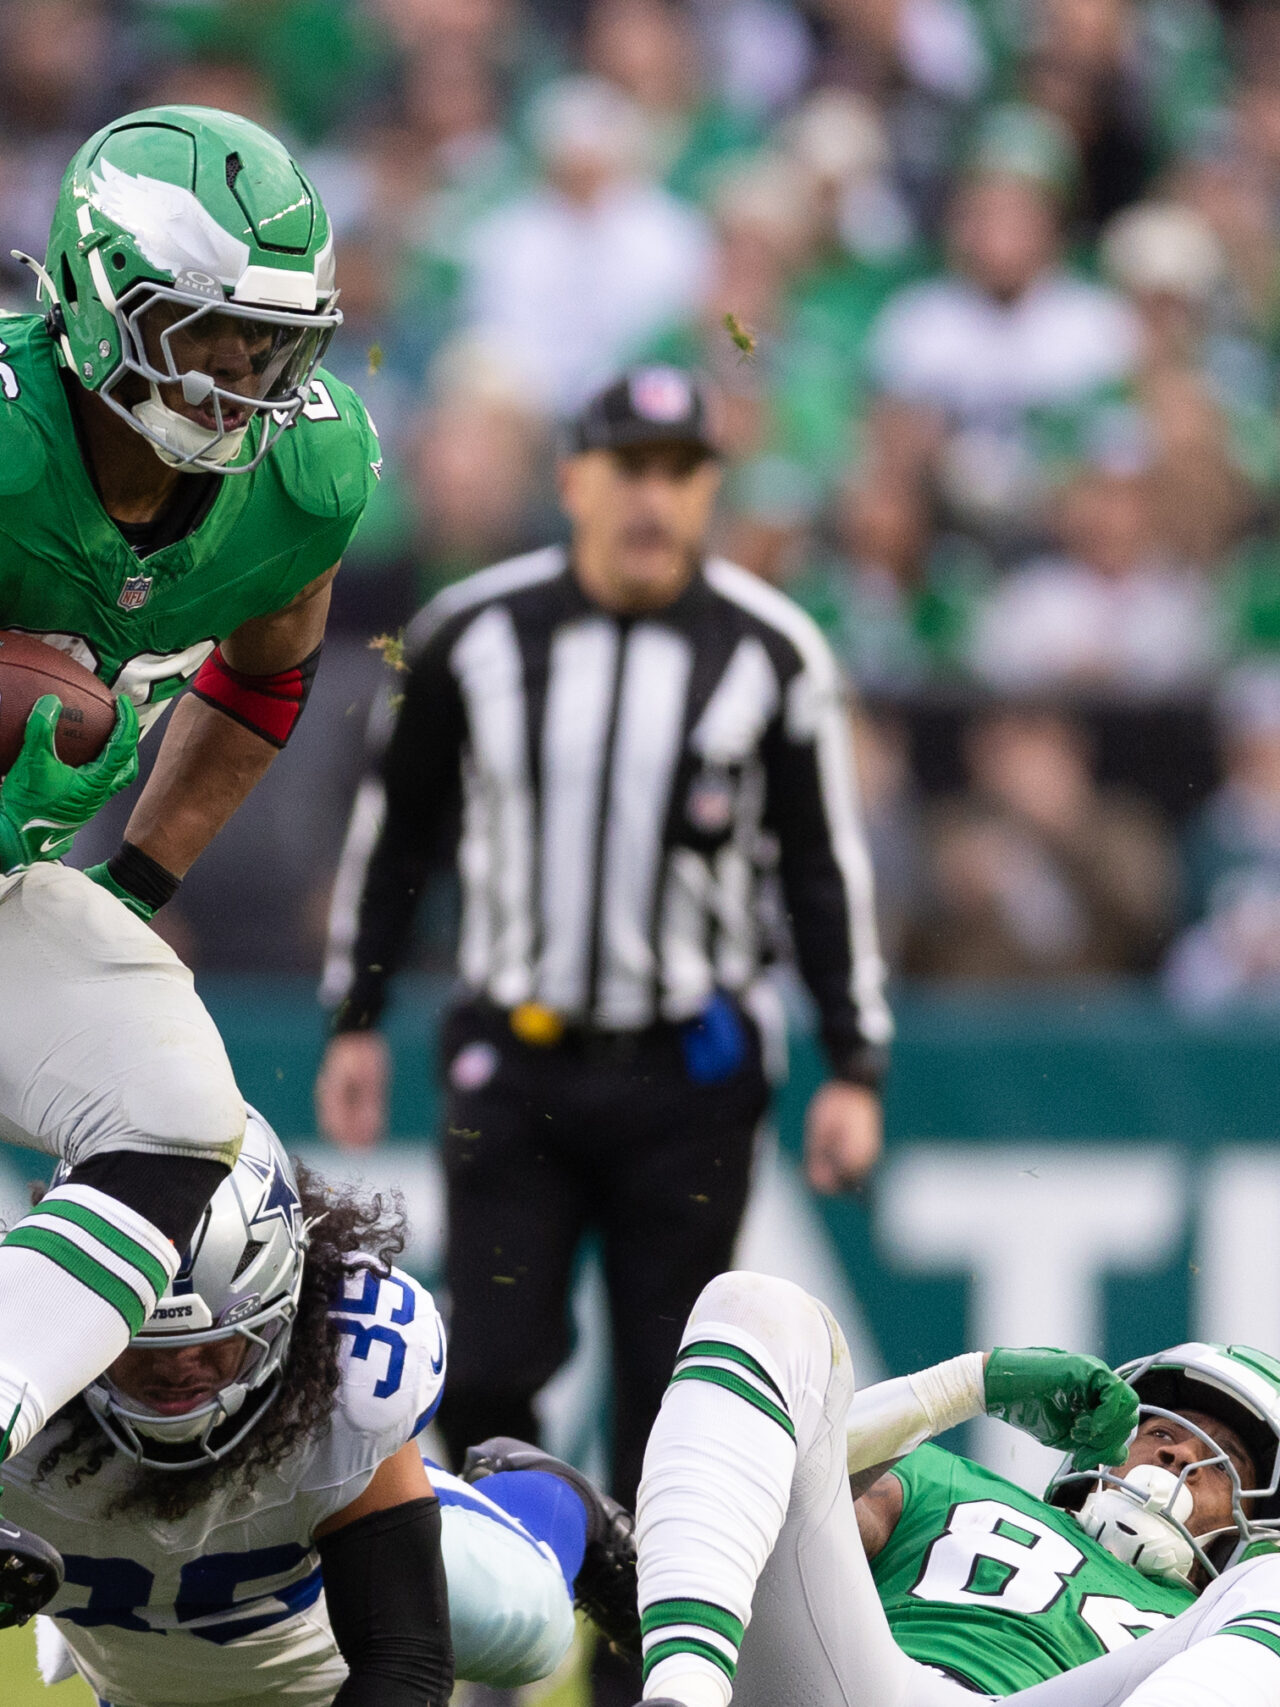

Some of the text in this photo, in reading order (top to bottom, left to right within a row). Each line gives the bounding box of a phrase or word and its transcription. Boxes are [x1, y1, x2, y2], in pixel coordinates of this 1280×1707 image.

[177, 276, 220, 296] OAKLEY
[122, 591, 144, 605] NFL
[224, 1302, 260, 1326] OAKLEY
[327, 1270, 416, 1400] 35
